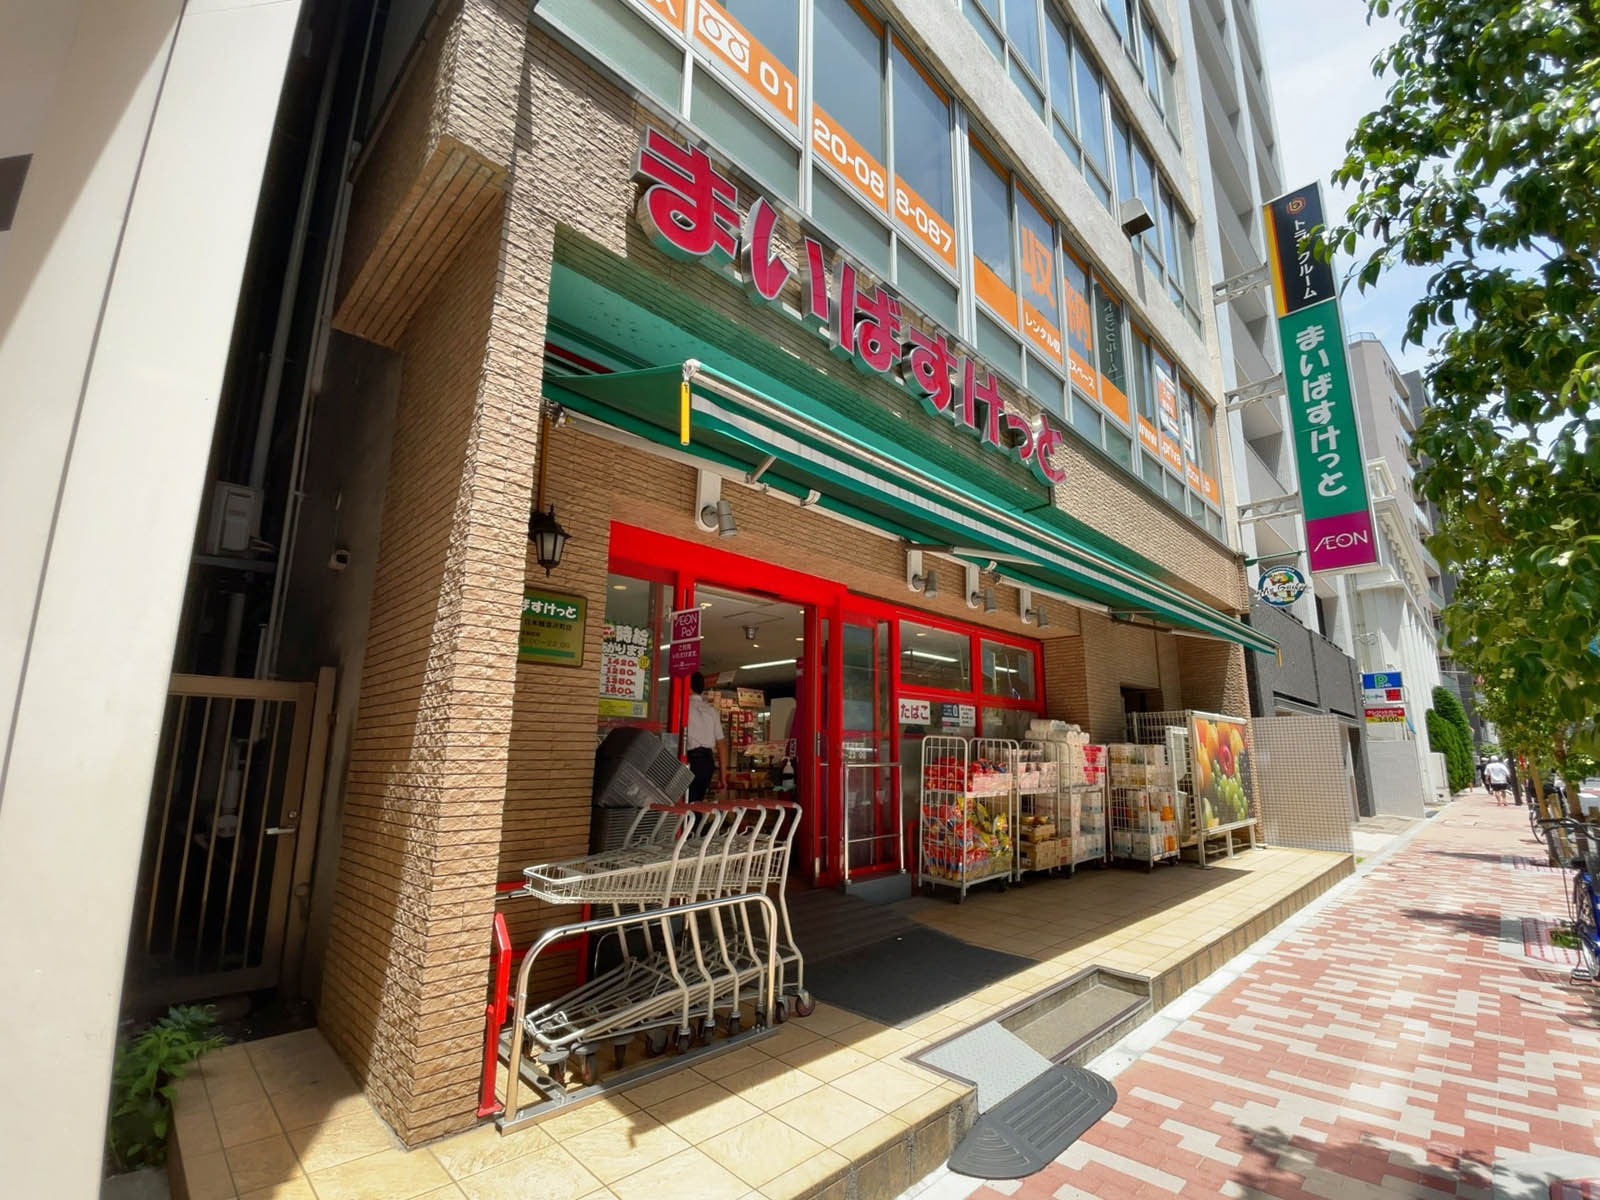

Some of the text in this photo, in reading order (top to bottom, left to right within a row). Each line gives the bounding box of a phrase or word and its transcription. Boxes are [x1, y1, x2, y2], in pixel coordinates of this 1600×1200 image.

[1294, 220, 1317, 299] トラクルーム
[633, 125, 1067, 487] まいばすけっと
[1296, 325, 1348, 497] まいばすけっと
[616, 625, 648, 647] 時給
[901, 703, 929, 720] たばこ
